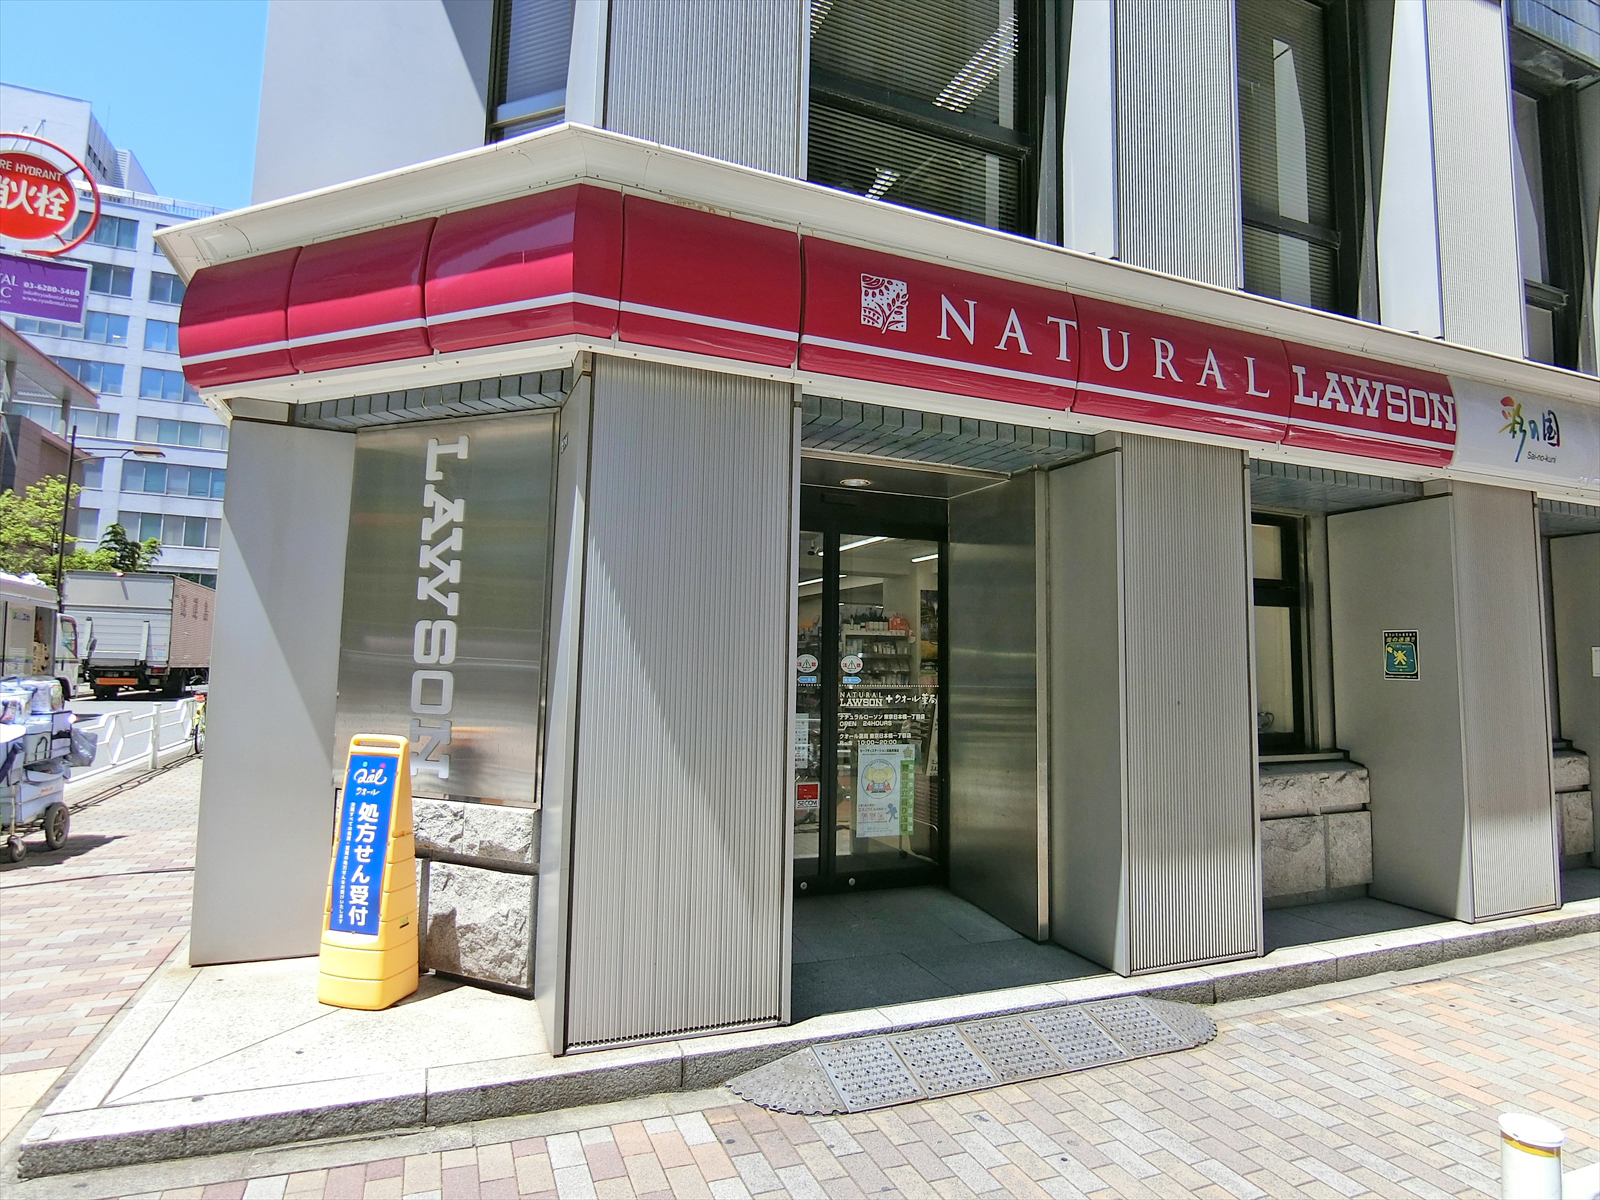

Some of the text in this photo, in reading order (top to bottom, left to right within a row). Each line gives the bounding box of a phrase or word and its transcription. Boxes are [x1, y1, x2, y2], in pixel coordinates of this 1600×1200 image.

[15, 163, 63, 182] HYDRANT
[23, 281, 80, 297] 03-6280-5460
[935, 293, 1457, 432] NATURAL LAWSON
[1527, 451, 1557, 464] Sai-no-kuni
[410, 434, 471, 780] LAWSON
[839, 698, 884, 707] LAWSON
[894, 692, 938, 706] クオール薬局
[355, 786, 381, 797] クオール
[348, 801, 380, 926] 処方せん受付
